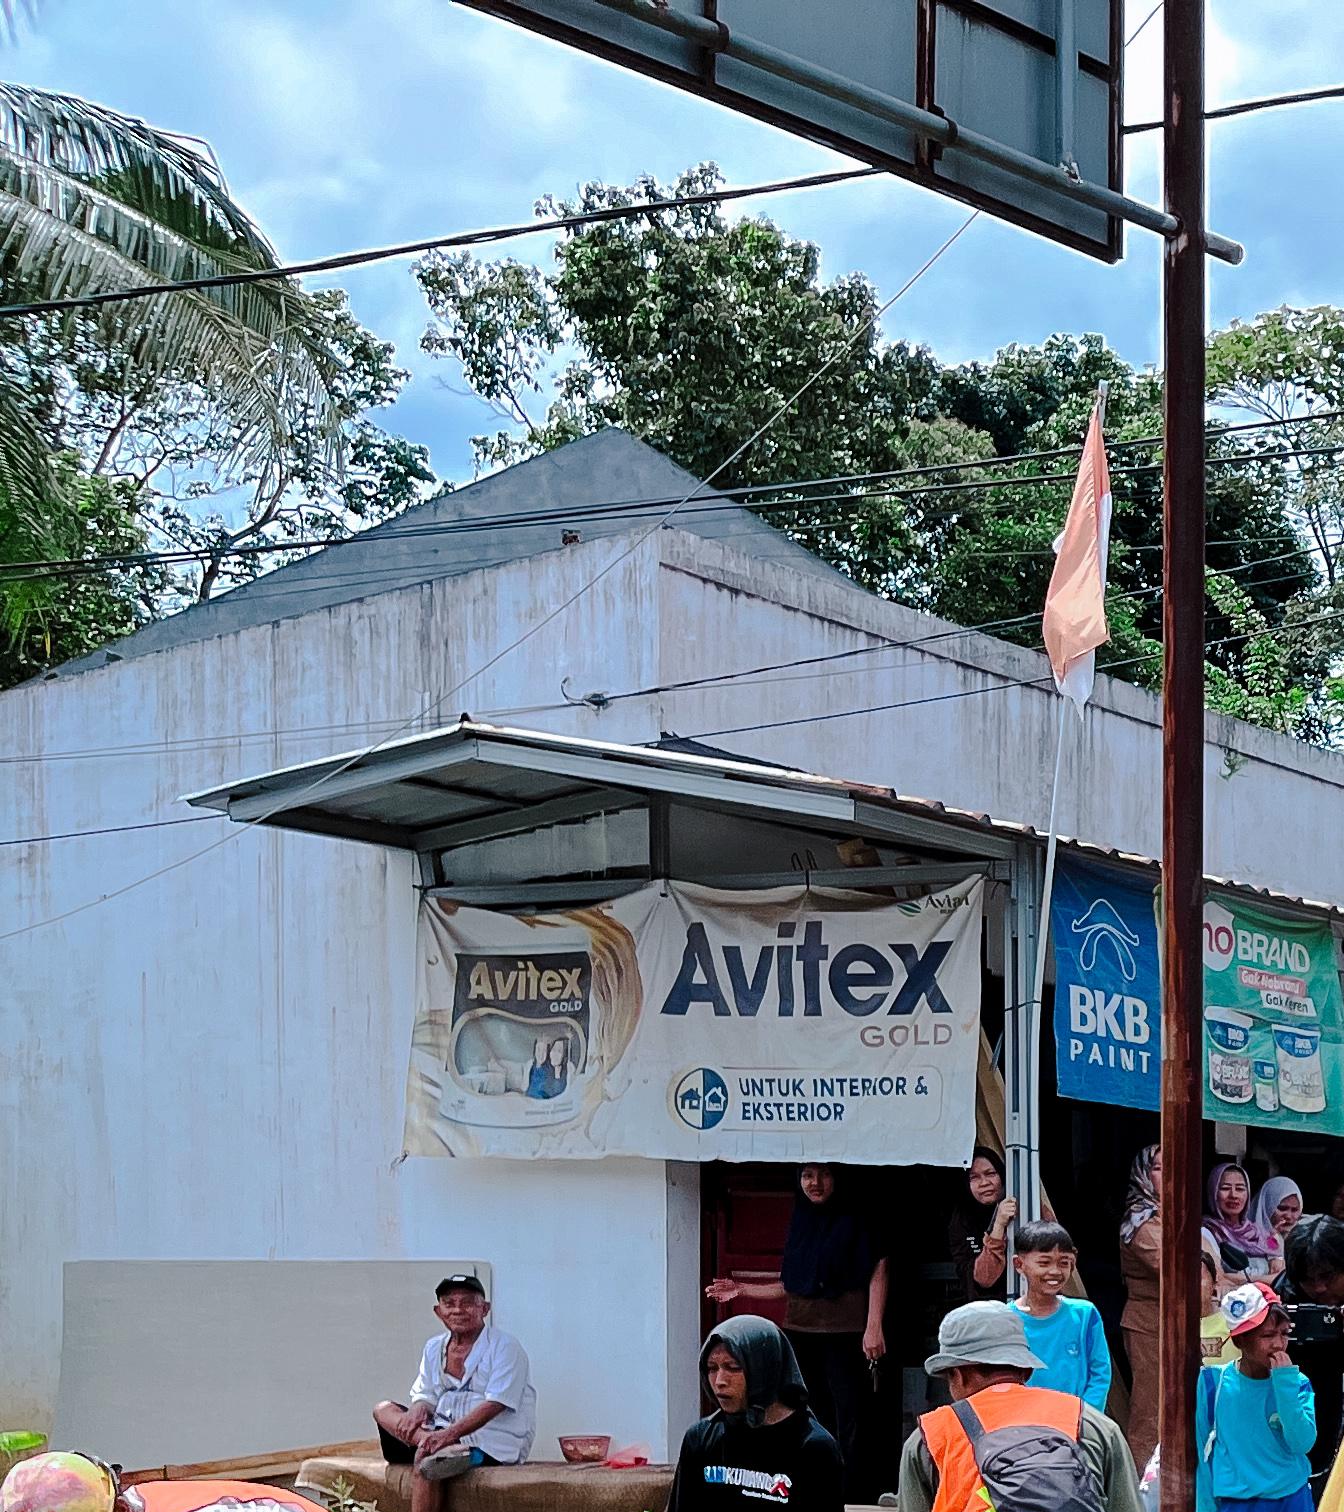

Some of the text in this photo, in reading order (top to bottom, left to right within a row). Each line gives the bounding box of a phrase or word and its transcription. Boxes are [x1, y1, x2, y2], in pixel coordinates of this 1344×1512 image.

[1237, 929, 1310, 973] BRAND
[467, 961, 583, 1000] Avitex
[660, 920, 954, 1017] Avitex
[550, 1001, 583, 1013] GOLD
[1069, 984, 1150, 1045] BKB
[860, 1023, 953, 1047] GOLD
[1070, 1039, 1151, 1073] PAINT
[738, 1075, 929, 1098] UNTUK INTERIOR &
[742, 1102, 845, 1122] EKSTERIOR
